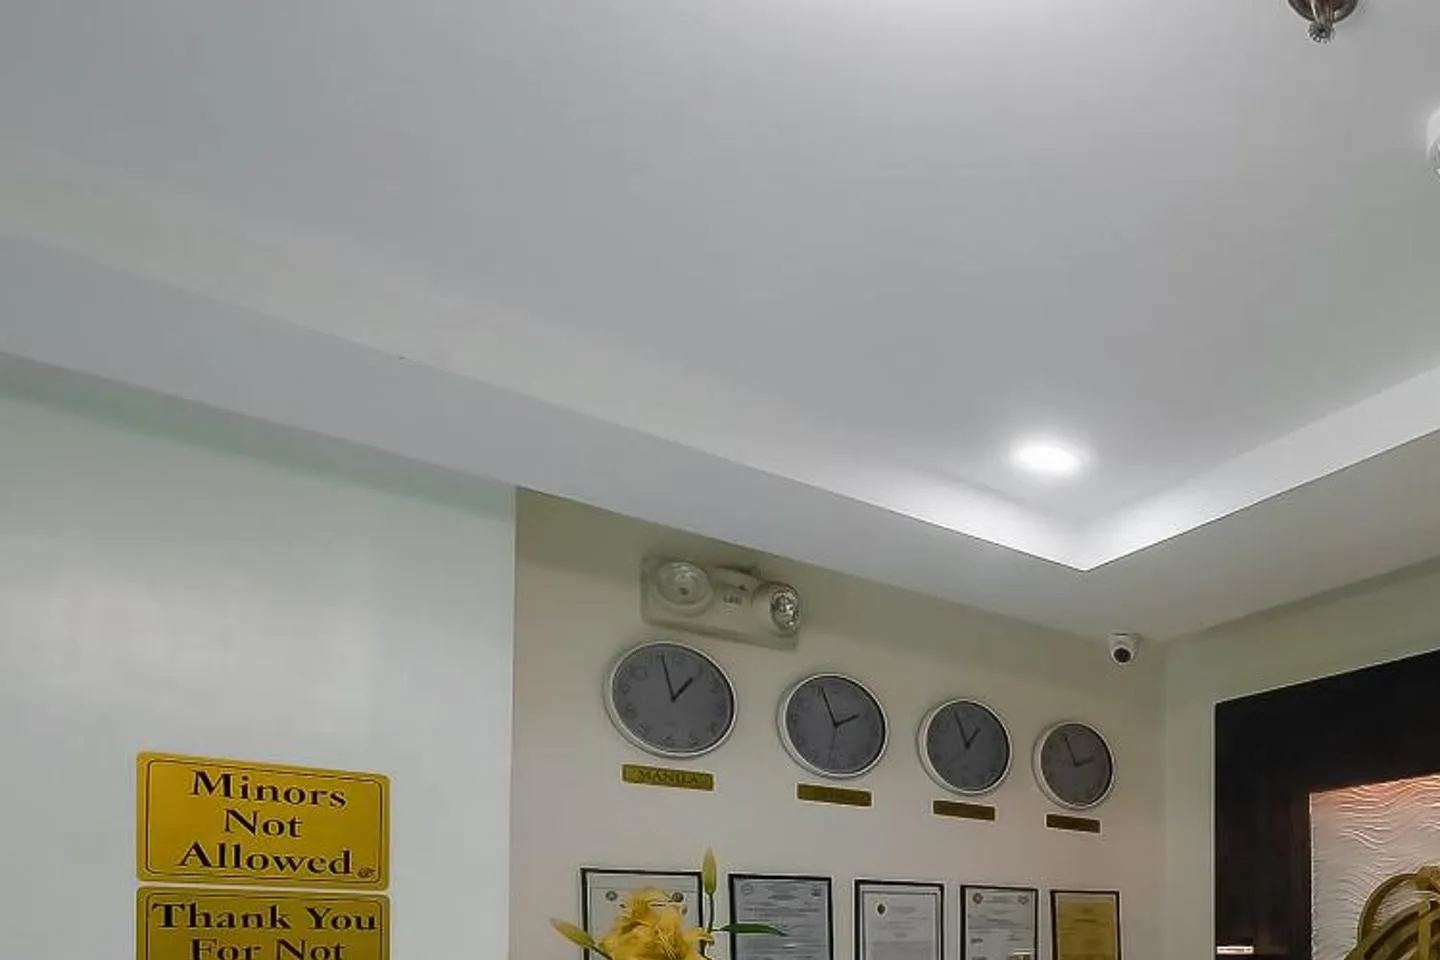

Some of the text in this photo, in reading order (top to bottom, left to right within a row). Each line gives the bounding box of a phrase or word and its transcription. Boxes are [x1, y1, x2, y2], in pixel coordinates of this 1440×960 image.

[191, 769, 347, 808] Minors
[224, 808, 303, 838] Not
[177, 841, 353, 875] Allowed
[152, 902, 379, 931] Thank You
